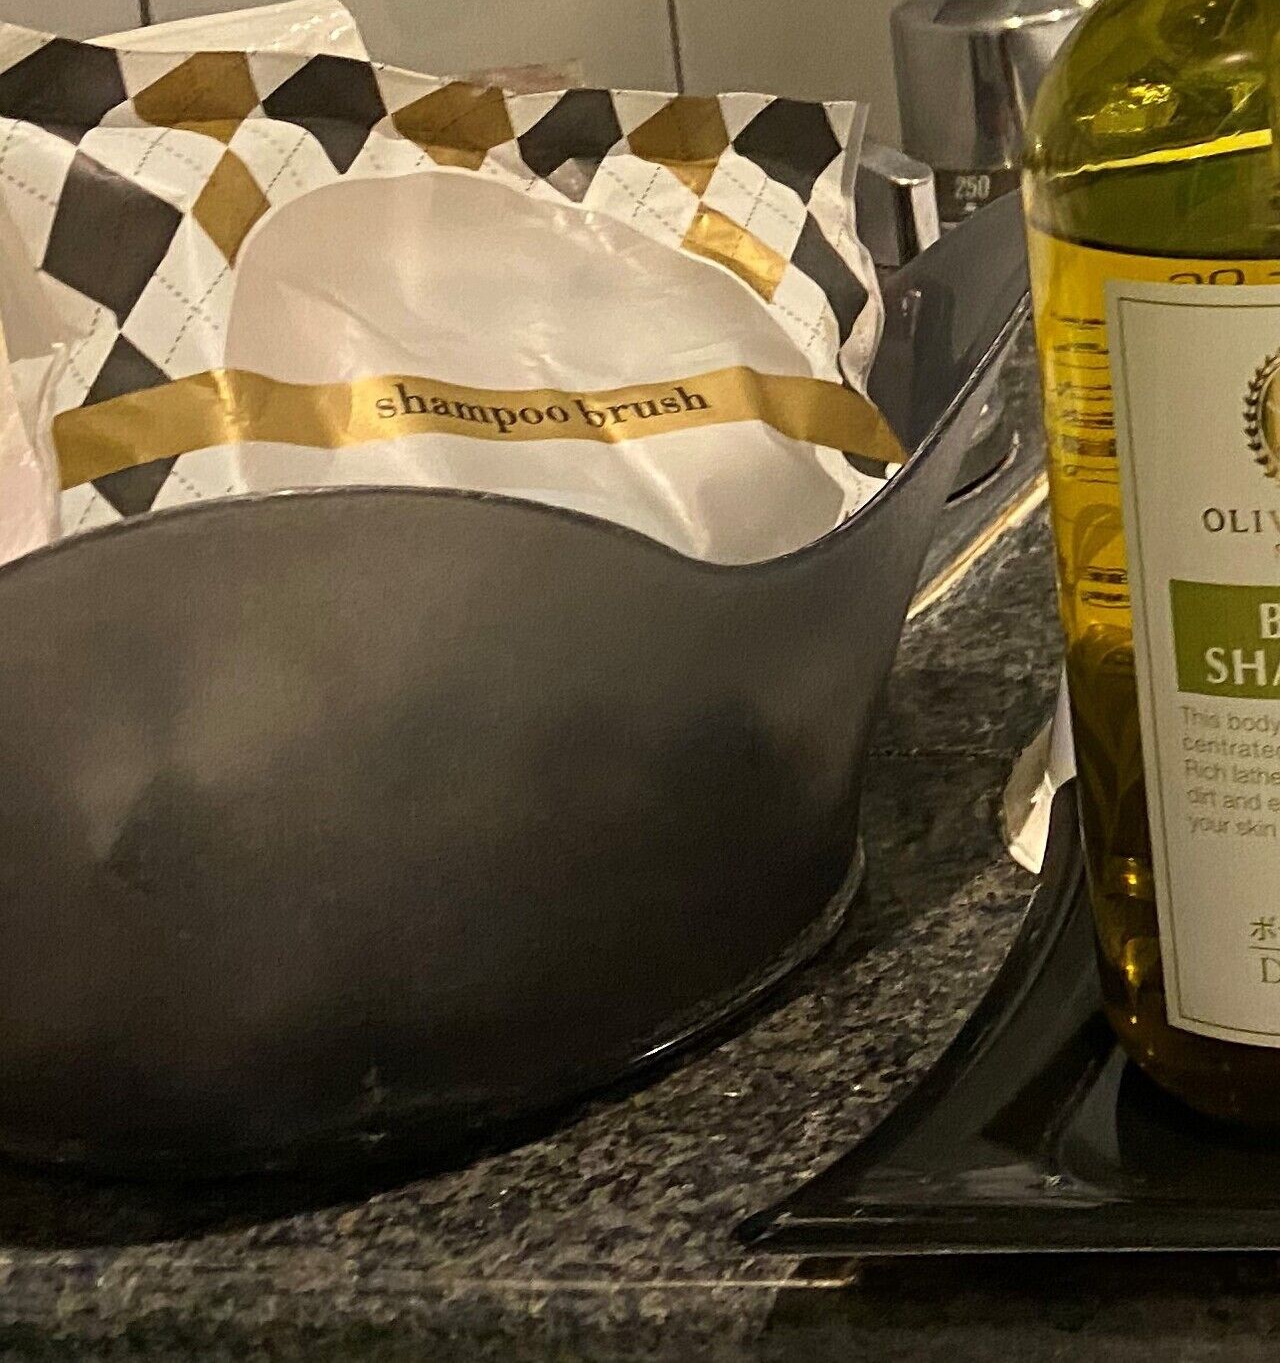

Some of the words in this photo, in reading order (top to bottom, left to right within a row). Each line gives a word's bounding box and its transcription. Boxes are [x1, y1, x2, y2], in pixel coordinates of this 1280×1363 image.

[375, 383, 569, 434] shampoo
[573, 386, 711, 429] brush
[1180, 705, 1220, 729] This
[1184, 758, 1226, 780] Rich
[1223, 794, 1261, 812] and
[1186, 815, 1230, 836] your
[1236, 819, 1276, 837] skin
